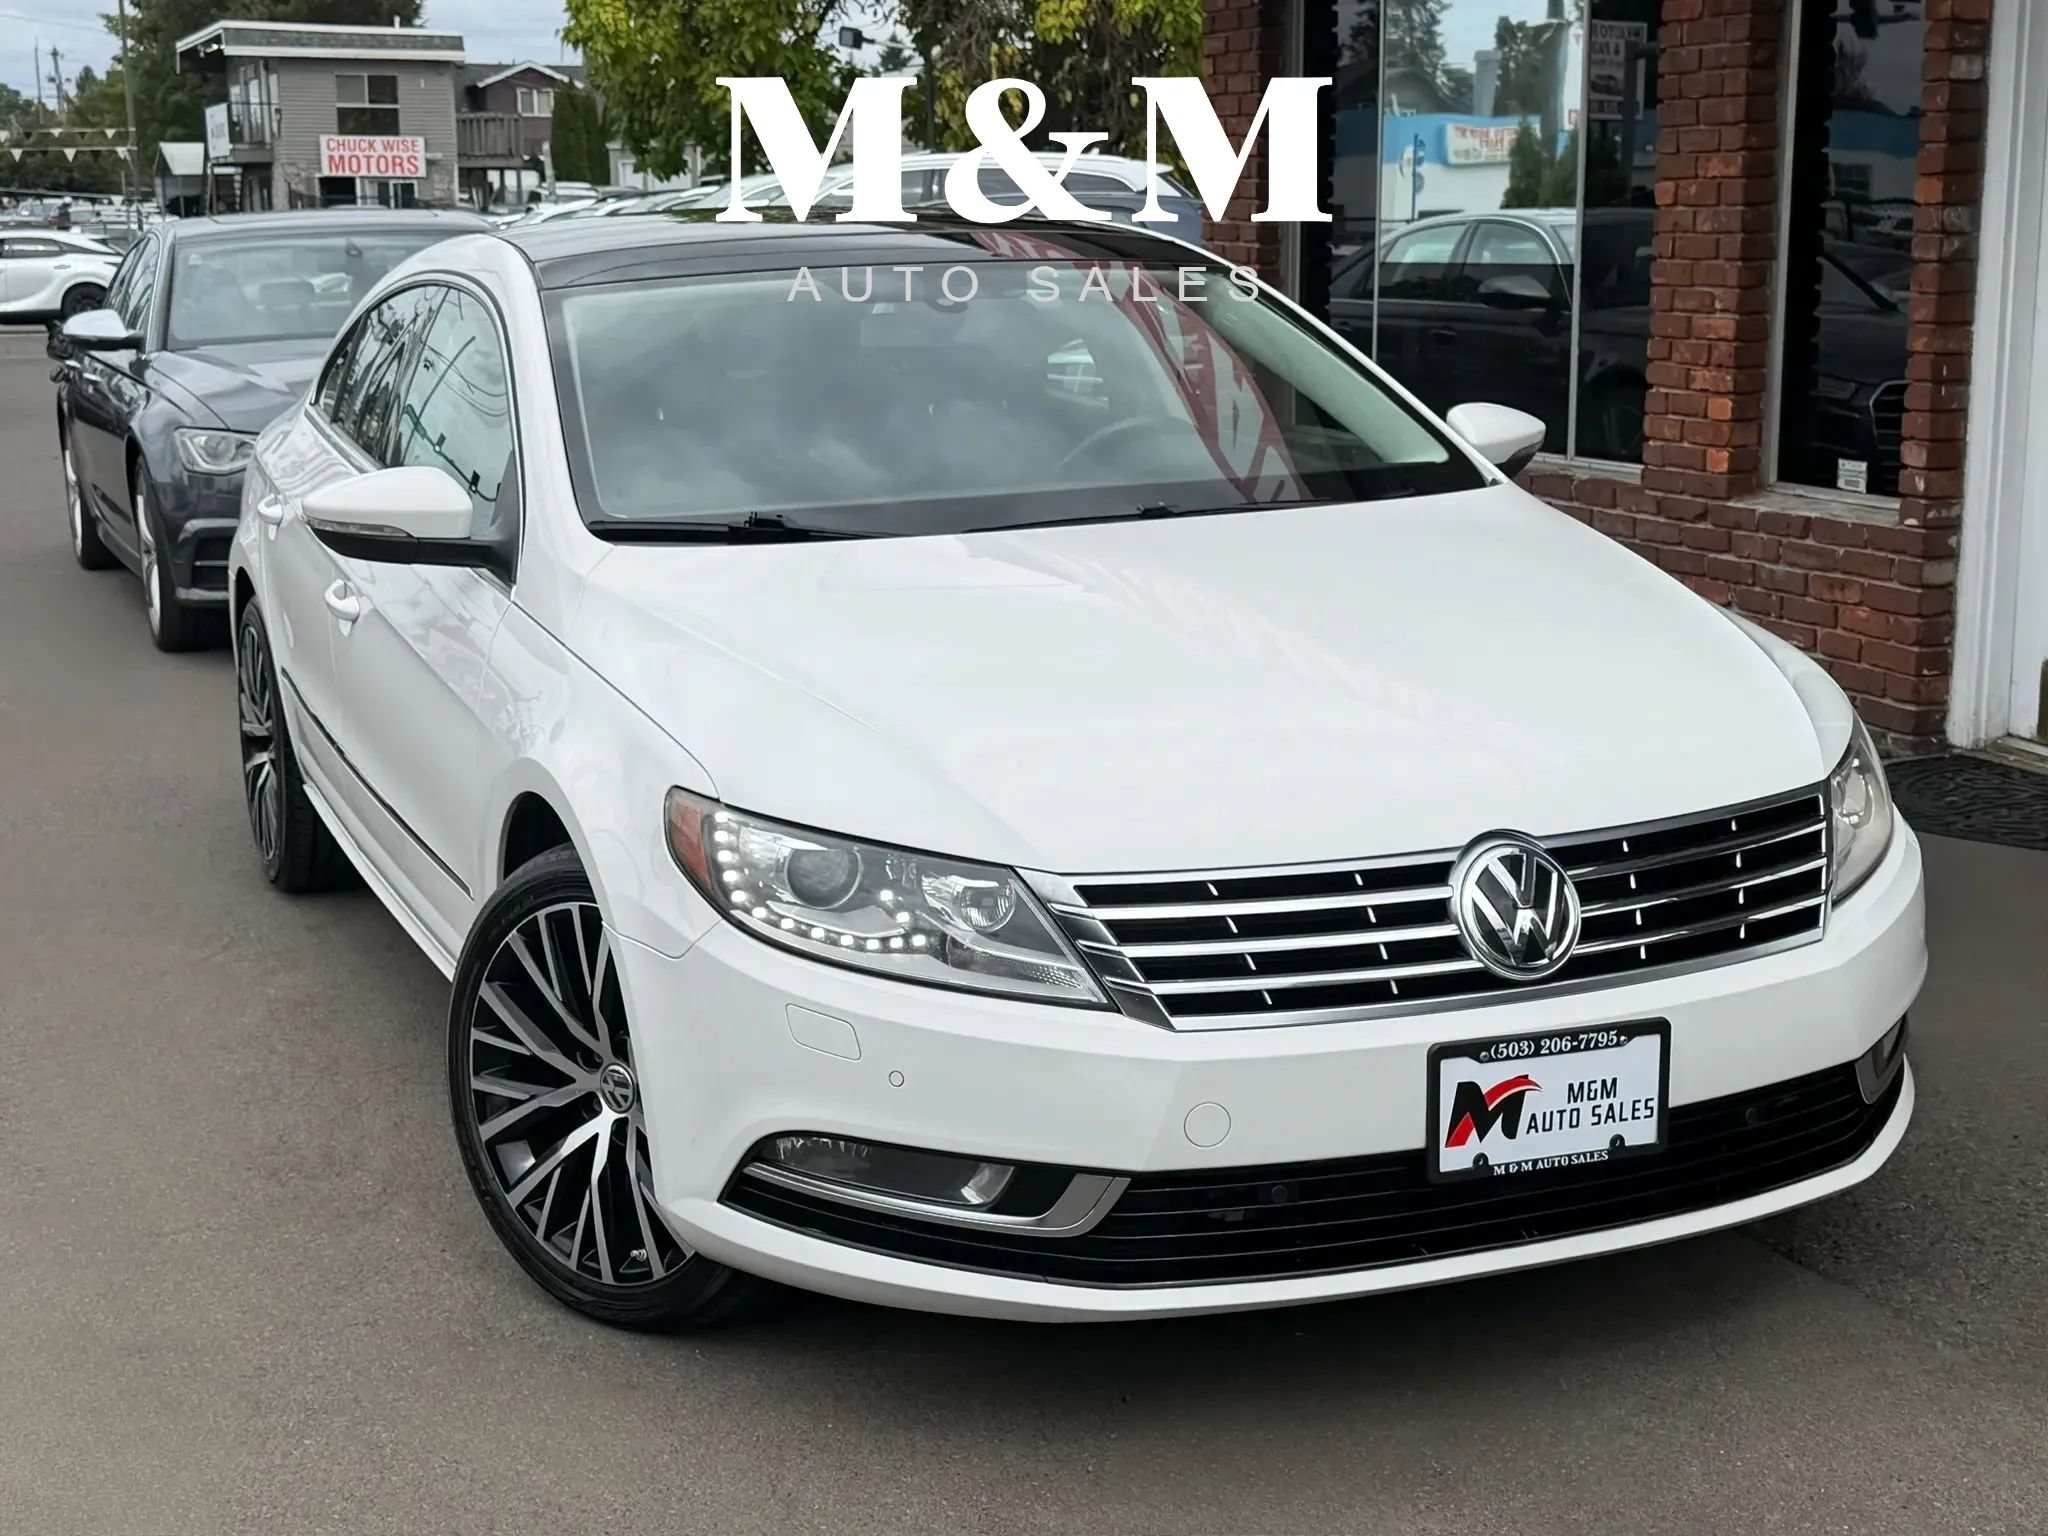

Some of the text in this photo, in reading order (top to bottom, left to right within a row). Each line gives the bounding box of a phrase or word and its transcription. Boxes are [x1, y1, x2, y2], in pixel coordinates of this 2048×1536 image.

[327, 138, 419, 154] CHUCK WISE
[328, 154, 419, 175] MOTORS
[1490, 1029, 1619, 1060] (503) 206-7795
[1567, 1076, 1618, 1105] M&M
[1526, 1097, 1655, 1135] AUTO SALES
[1493, 1164, 1506, 1176] M
[1520, 1160, 1533, 1172] M
[1536, 1156, 1569, 1170] AUTO
[1570, 1150, 1609, 1165] SALES
